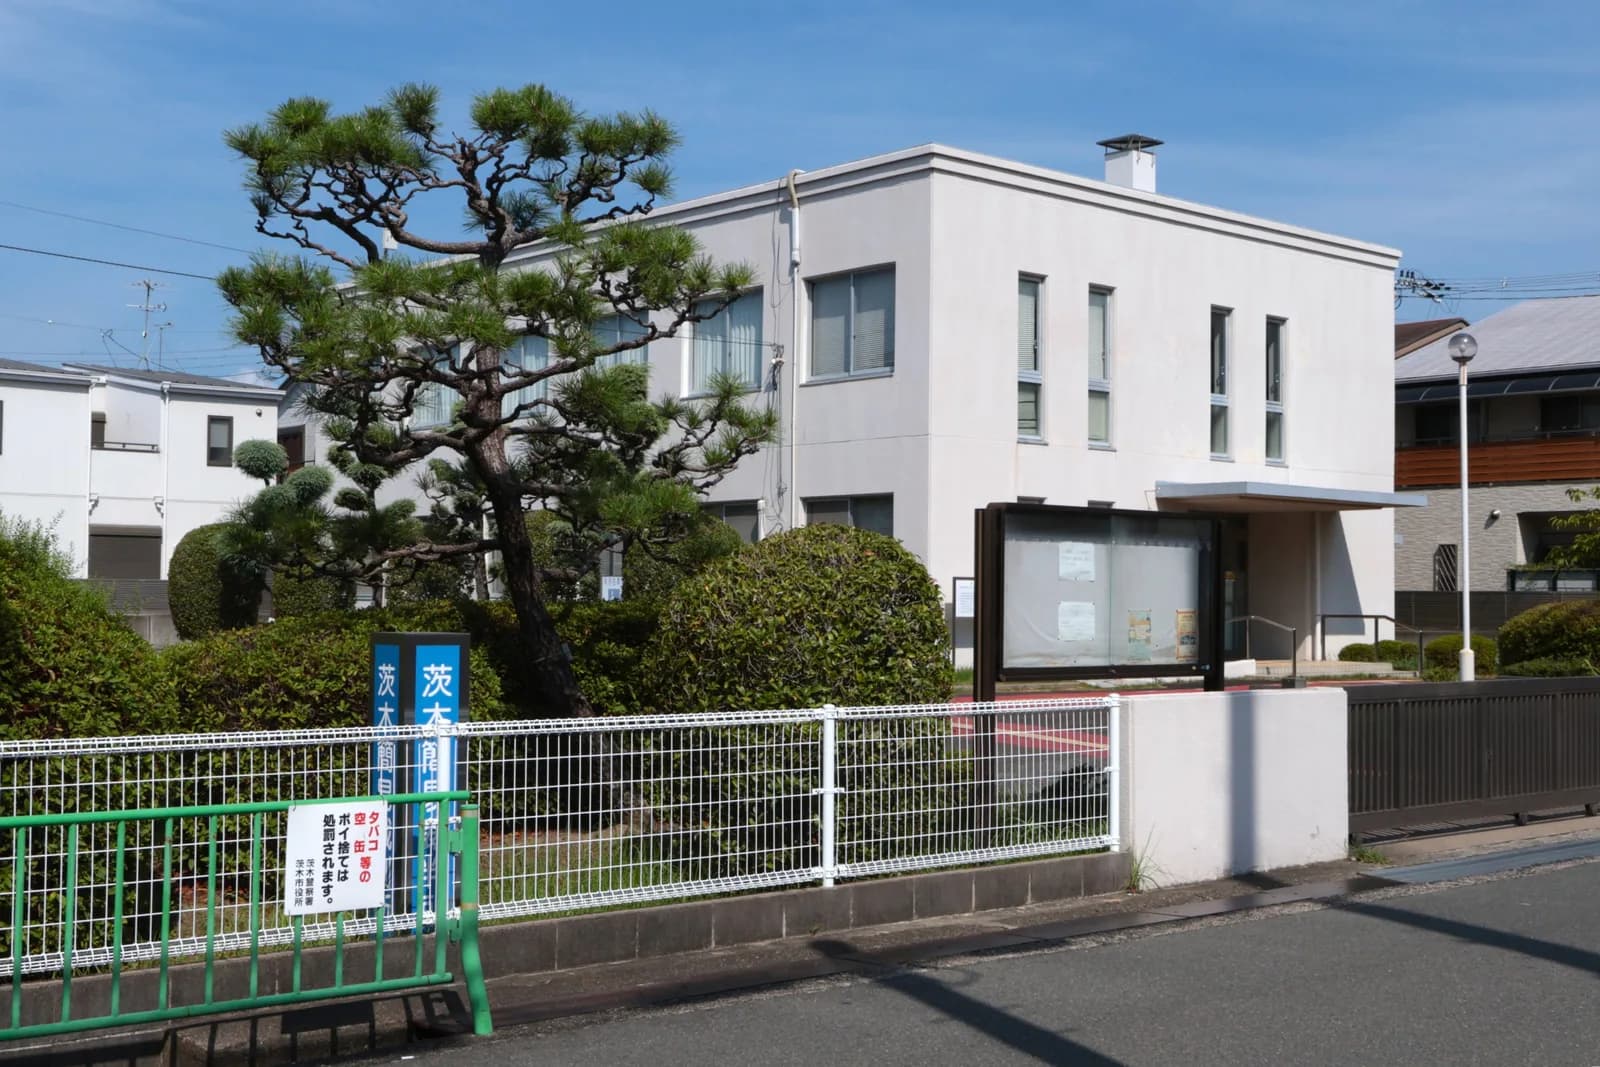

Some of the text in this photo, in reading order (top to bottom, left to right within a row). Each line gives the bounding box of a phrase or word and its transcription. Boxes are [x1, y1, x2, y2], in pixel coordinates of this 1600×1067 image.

[321, 814, 336, 904] 処罰されます。
[337, 813, 351, 882] ポイ捨ては
[368, 811, 380, 851] タバコ
[294, 859, 304, 908] 茨木市役所
